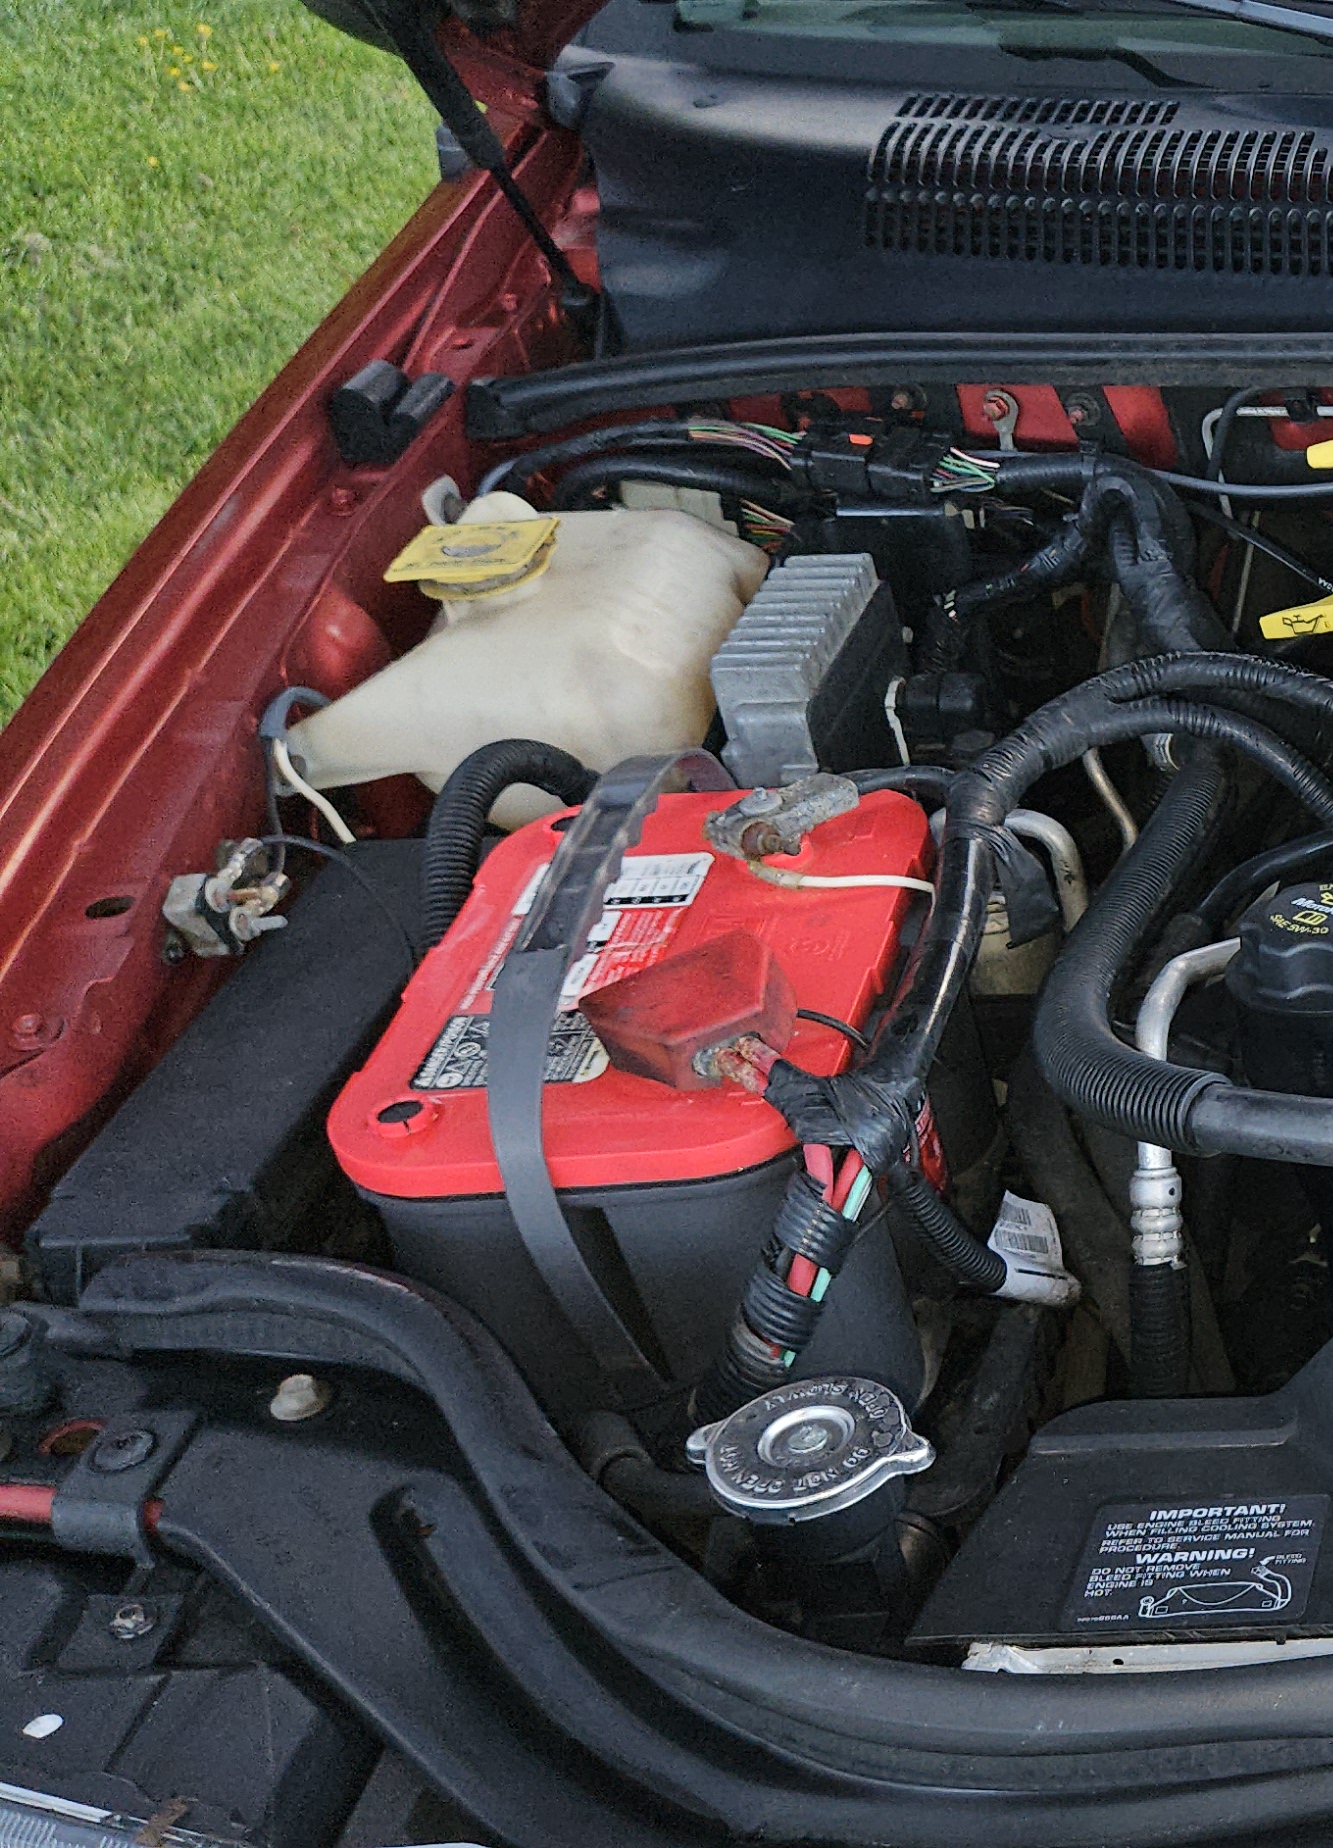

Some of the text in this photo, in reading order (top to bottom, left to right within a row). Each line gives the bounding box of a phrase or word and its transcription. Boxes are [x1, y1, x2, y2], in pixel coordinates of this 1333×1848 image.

[1269, 914, 1330, 934] SAE 5W-30
[731, 1472, 786, 1494] OPEN
[792, 1465, 840, 1493] NOT
[1149, 1503, 1287, 1521] IMPORTANT!
[1105, 1529, 1147, 1539] WHEN
[1149, 1526, 1198, 1535] FILLING
[1200, 1523, 1258, 1532] COOLING
[1107, 1515, 1282, 1531] USE ENGINE BLEED FITTING
[1101, 1537, 1144, 1547] REFER
[1166, 1533, 1221, 1543] SERVICE
[1224, 1530, 1281, 1540] MANUAL
[1283, 1528, 1310, 1537] FOR
[1136, 1547, 1256, 1565] WARNING!
[1088, 1568, 1232, 1583] BLEED FITTING WHEN
[1091, 1563, 1202, 1575] DO NOT REMOVE
[1086, 1580, 1137, 1590] ENGINE
